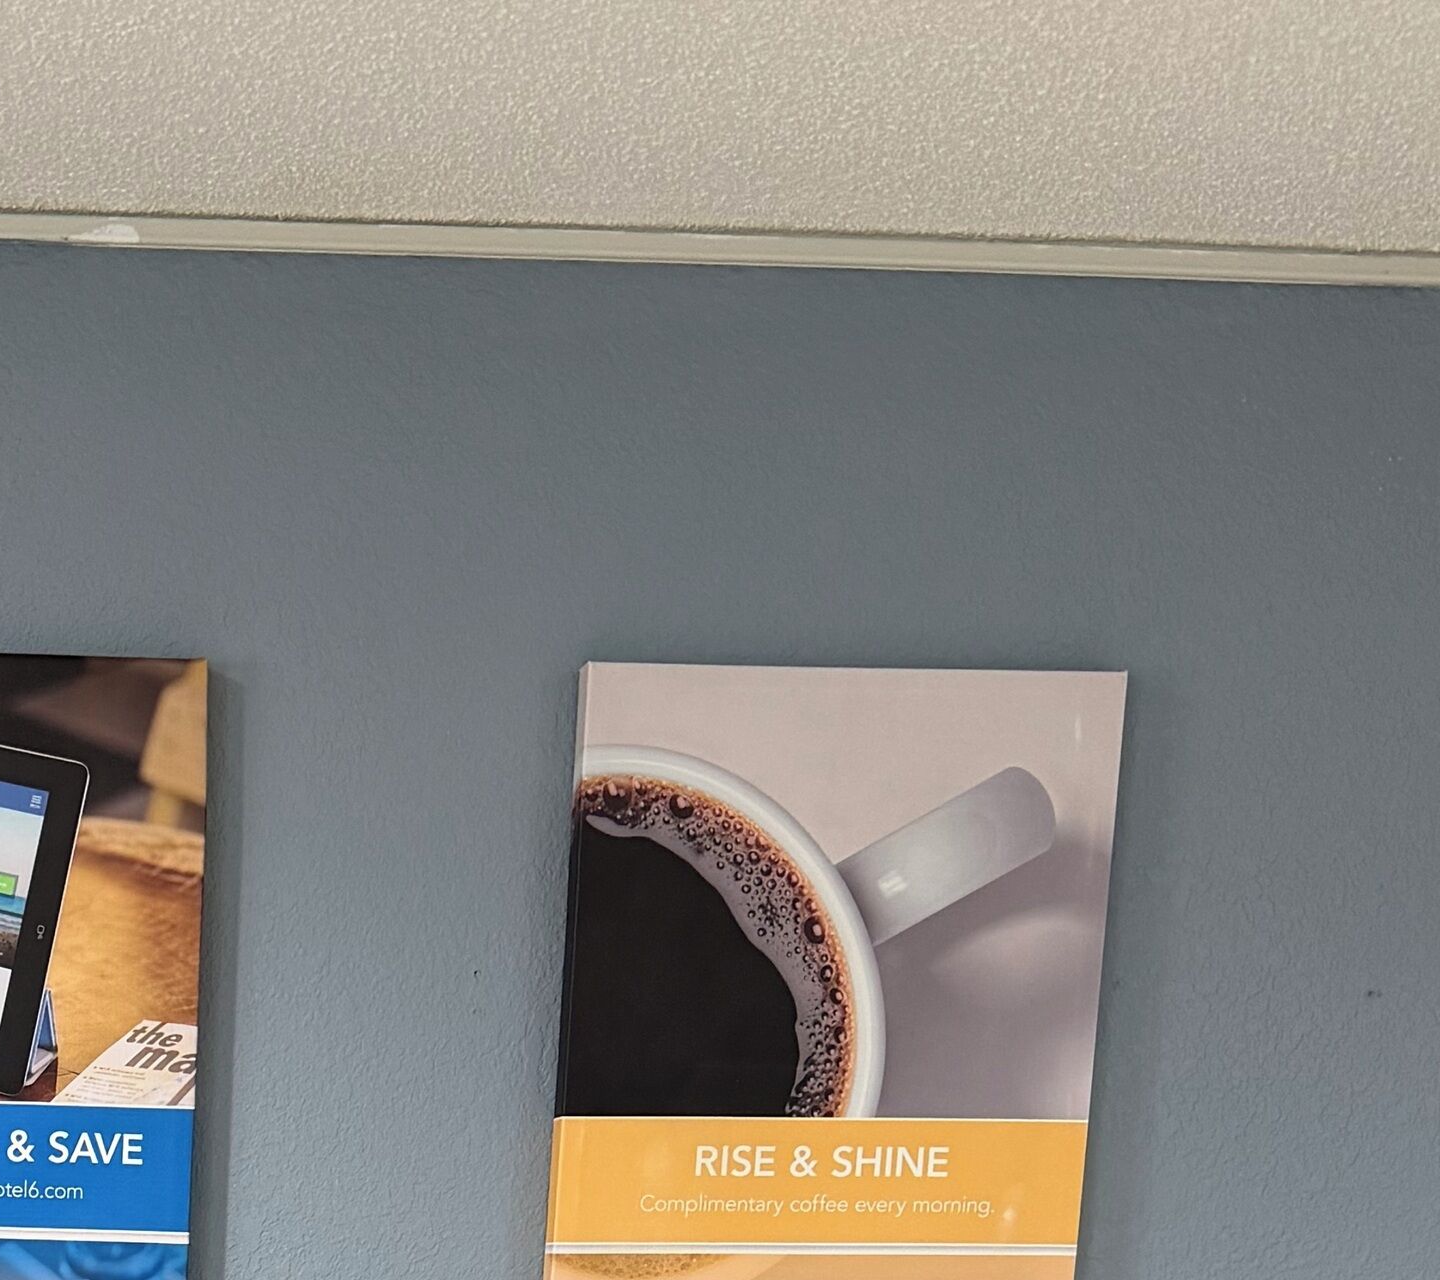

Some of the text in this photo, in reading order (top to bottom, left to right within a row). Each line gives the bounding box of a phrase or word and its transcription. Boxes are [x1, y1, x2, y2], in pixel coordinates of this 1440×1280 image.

[126, 1022, 183, 1047] the
[6, 1129, 35, 1163] &
[47, 1130, 144, 1166] SAVE
[694, 1144, 950, 1178] RISE & SHINE
[639, 1193, 995, 1218] Complimentary coffee every morning.
